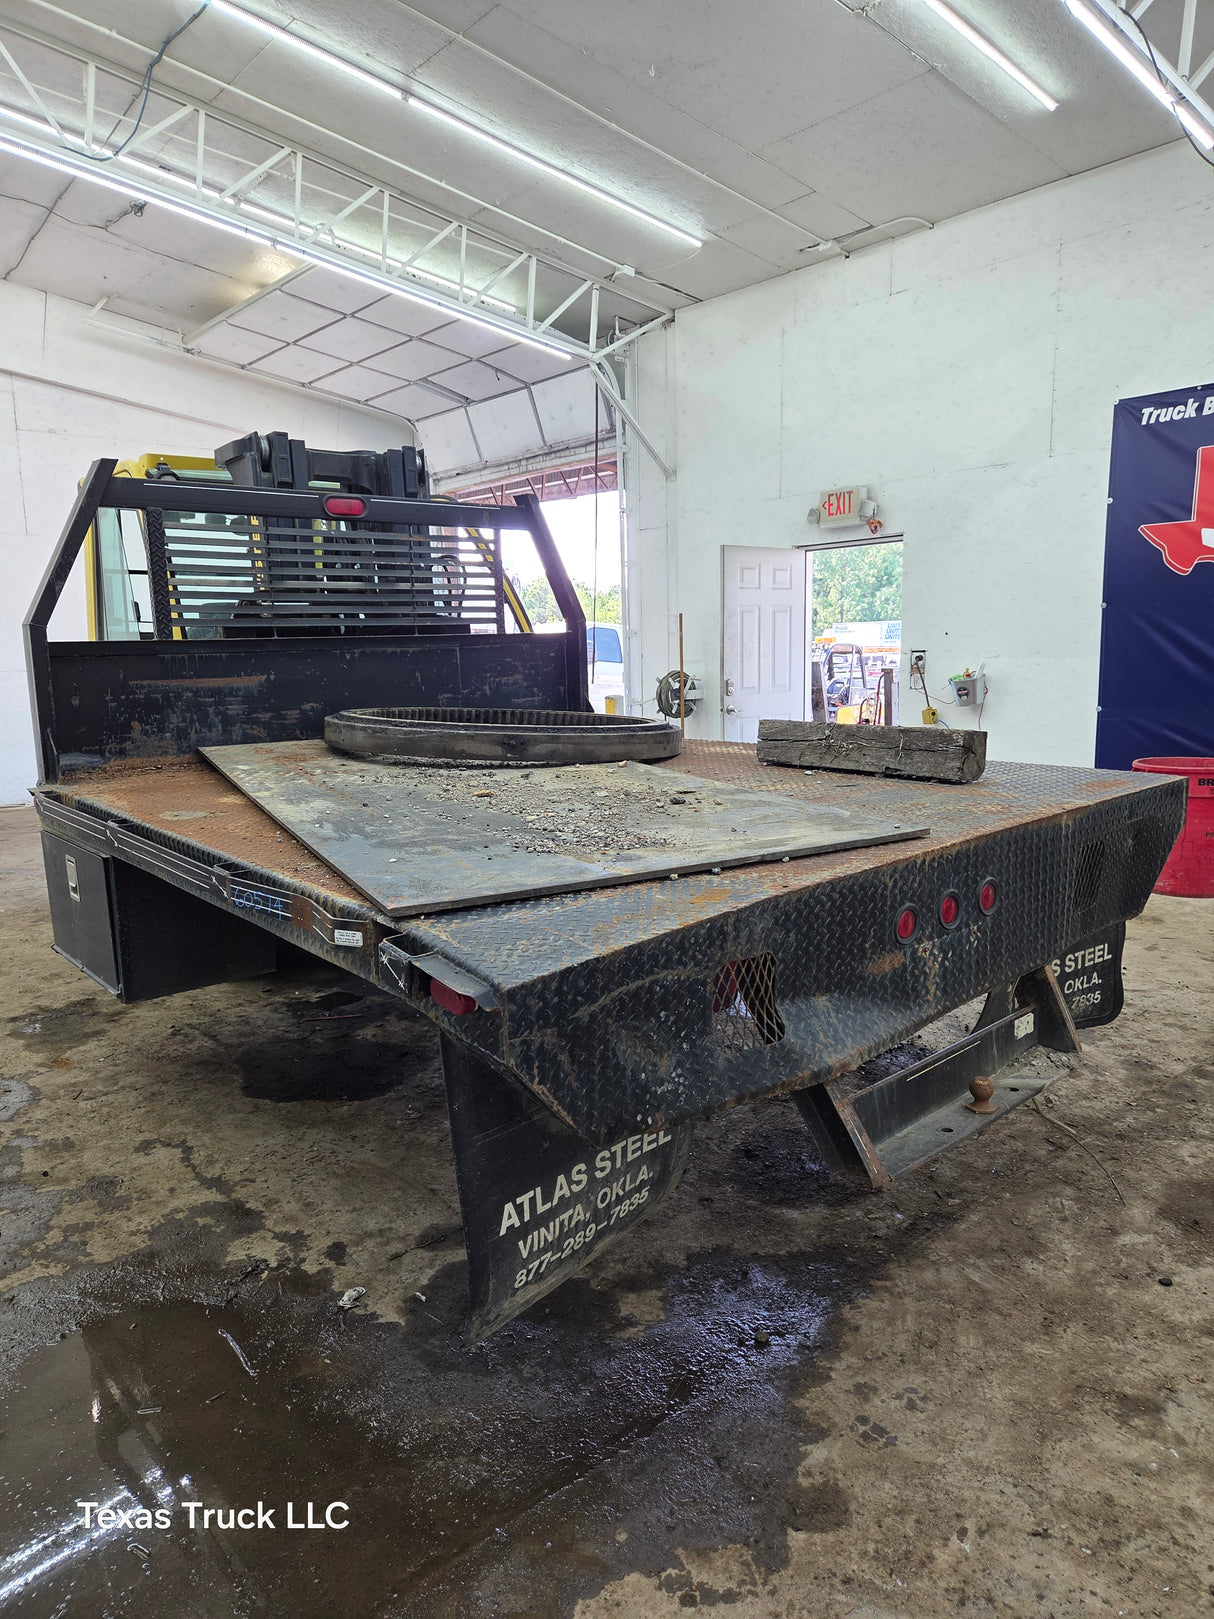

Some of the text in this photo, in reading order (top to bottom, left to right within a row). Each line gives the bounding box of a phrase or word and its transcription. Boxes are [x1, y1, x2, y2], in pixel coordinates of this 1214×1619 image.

[1141, 398, 1199, 425] Truck
[828, 491, 853, 516] EXIT
[1064, 943, 1112, 973] STEEL
[1064, 972, 1102, 994] OKLA.
[499, 1130, 672, 1237] ATLAS STEEL
[518, 1164, 654, 1259] VINITA, OKLA.
[514, 1186, 650, 1289] 877-289-7835
